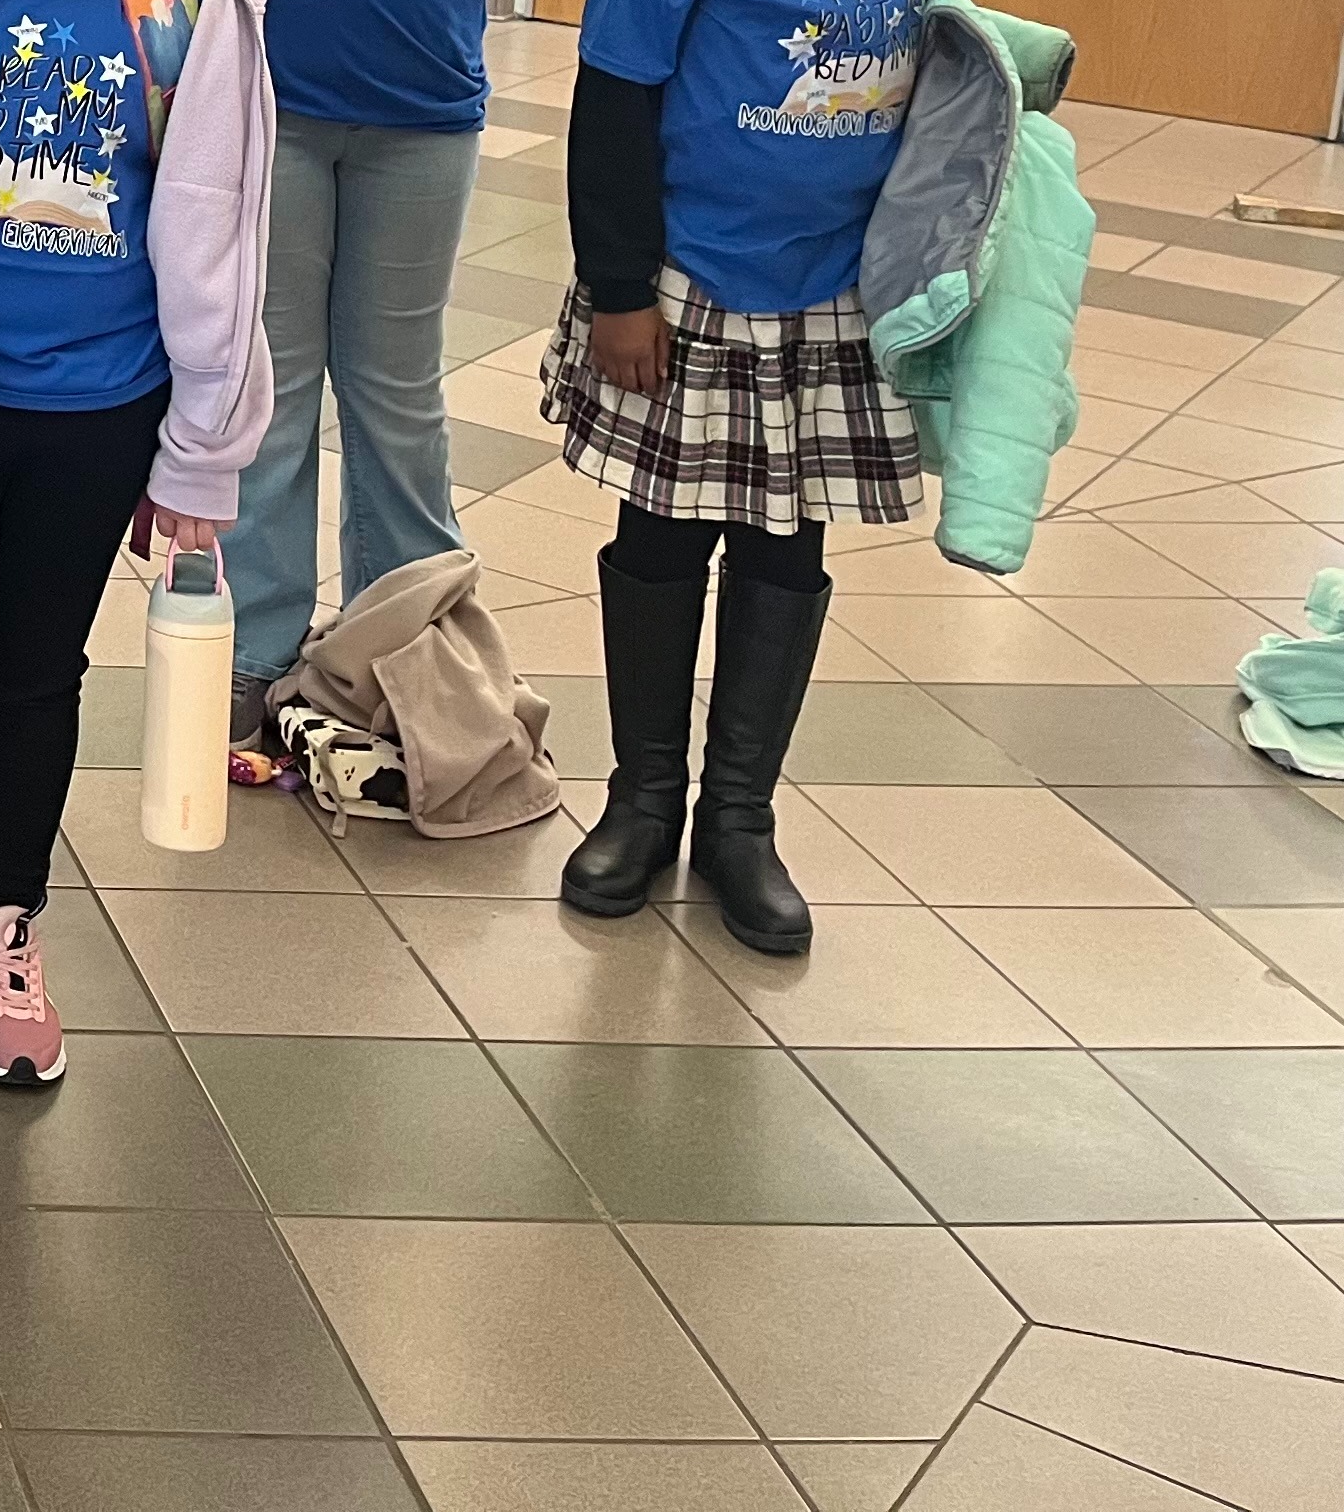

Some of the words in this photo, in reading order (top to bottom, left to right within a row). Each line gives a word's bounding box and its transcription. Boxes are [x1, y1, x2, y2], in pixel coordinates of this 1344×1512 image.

[0, 54, 96, 94] READ
[814, 33, 916, 83] BEDTIM
[56, 86, 120, 138] MY
